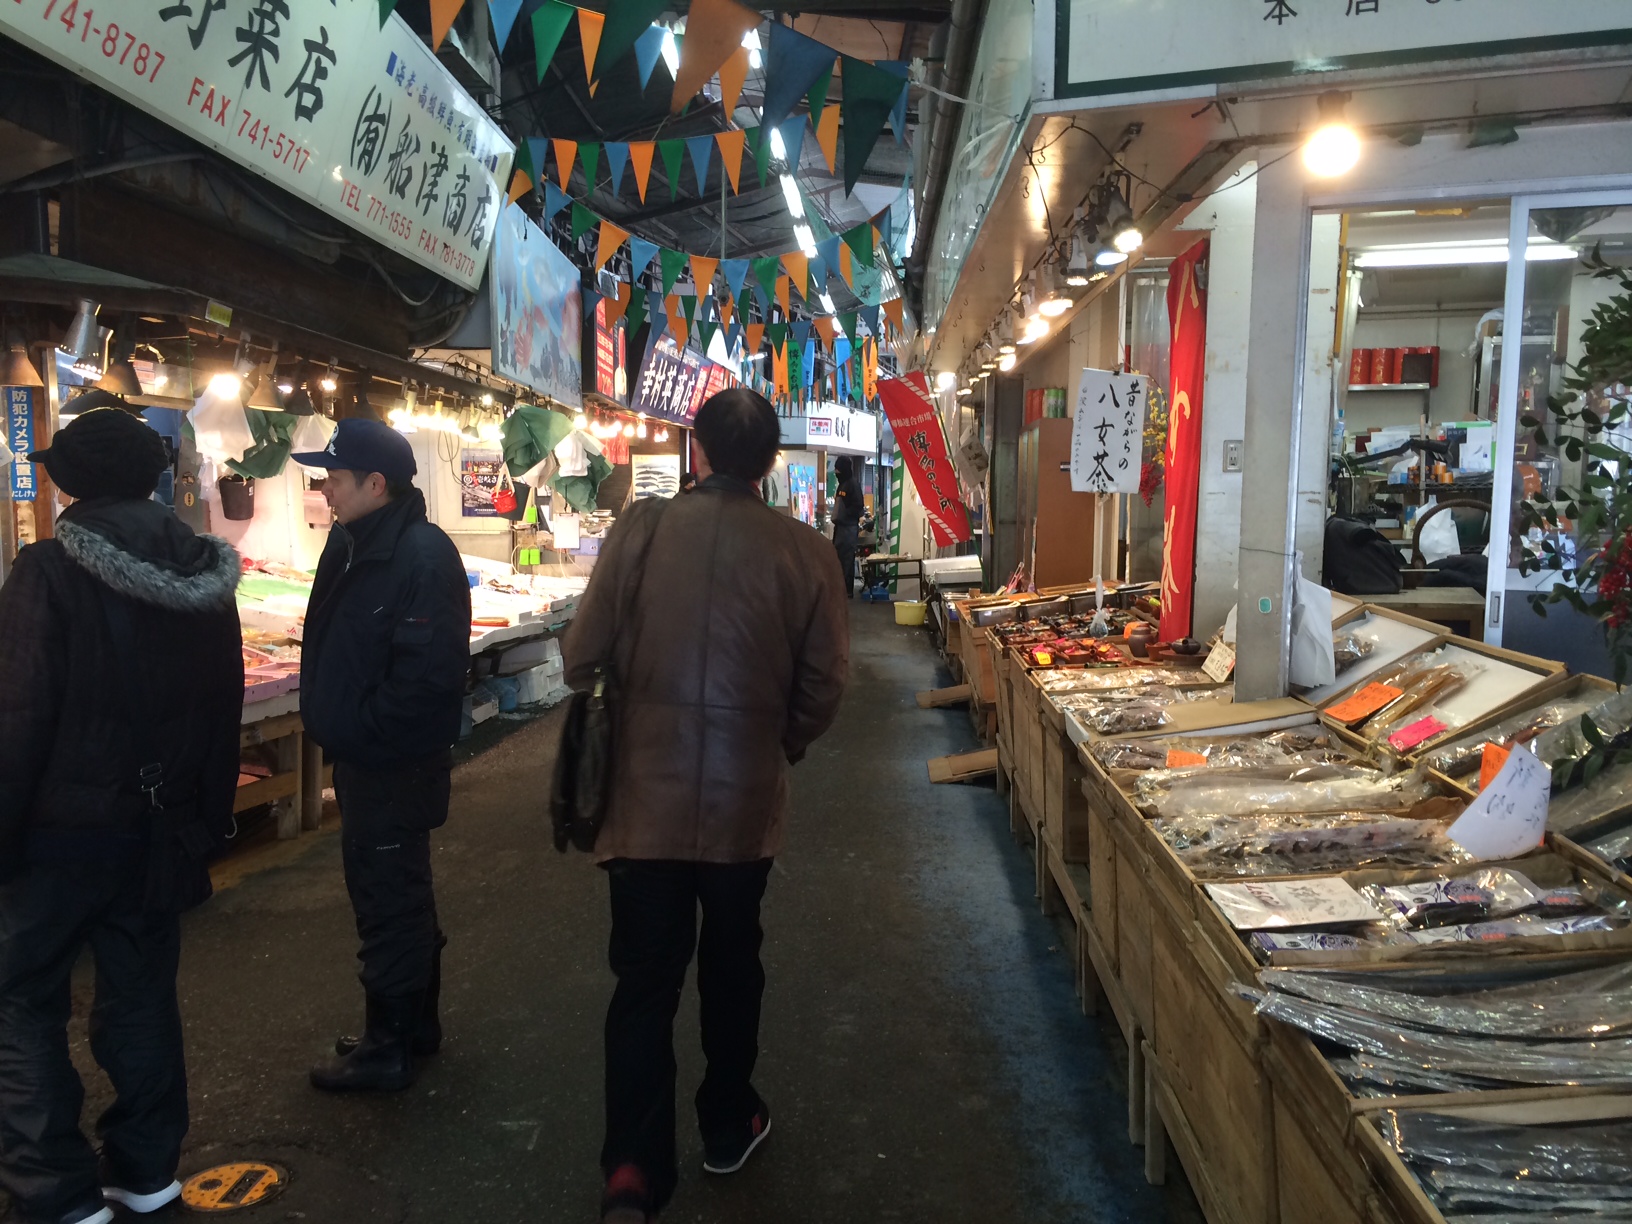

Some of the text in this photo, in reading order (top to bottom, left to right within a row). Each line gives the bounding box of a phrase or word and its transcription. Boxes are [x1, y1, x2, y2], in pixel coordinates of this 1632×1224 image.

[187, 76, 232, 127] FAX
[237, 109, 310, 174] 741-5717
[339, 179, 362, 213] TEL
[366, 196, 413, 240] 771-1555
[417, 228, 439, 256] FAX
[12, 390, 32, 489] 防犯カメラ設置店
[1086, 383, 1120, 496] 八女茶
[1118, 379, 1141, 471] 昔ながらの
